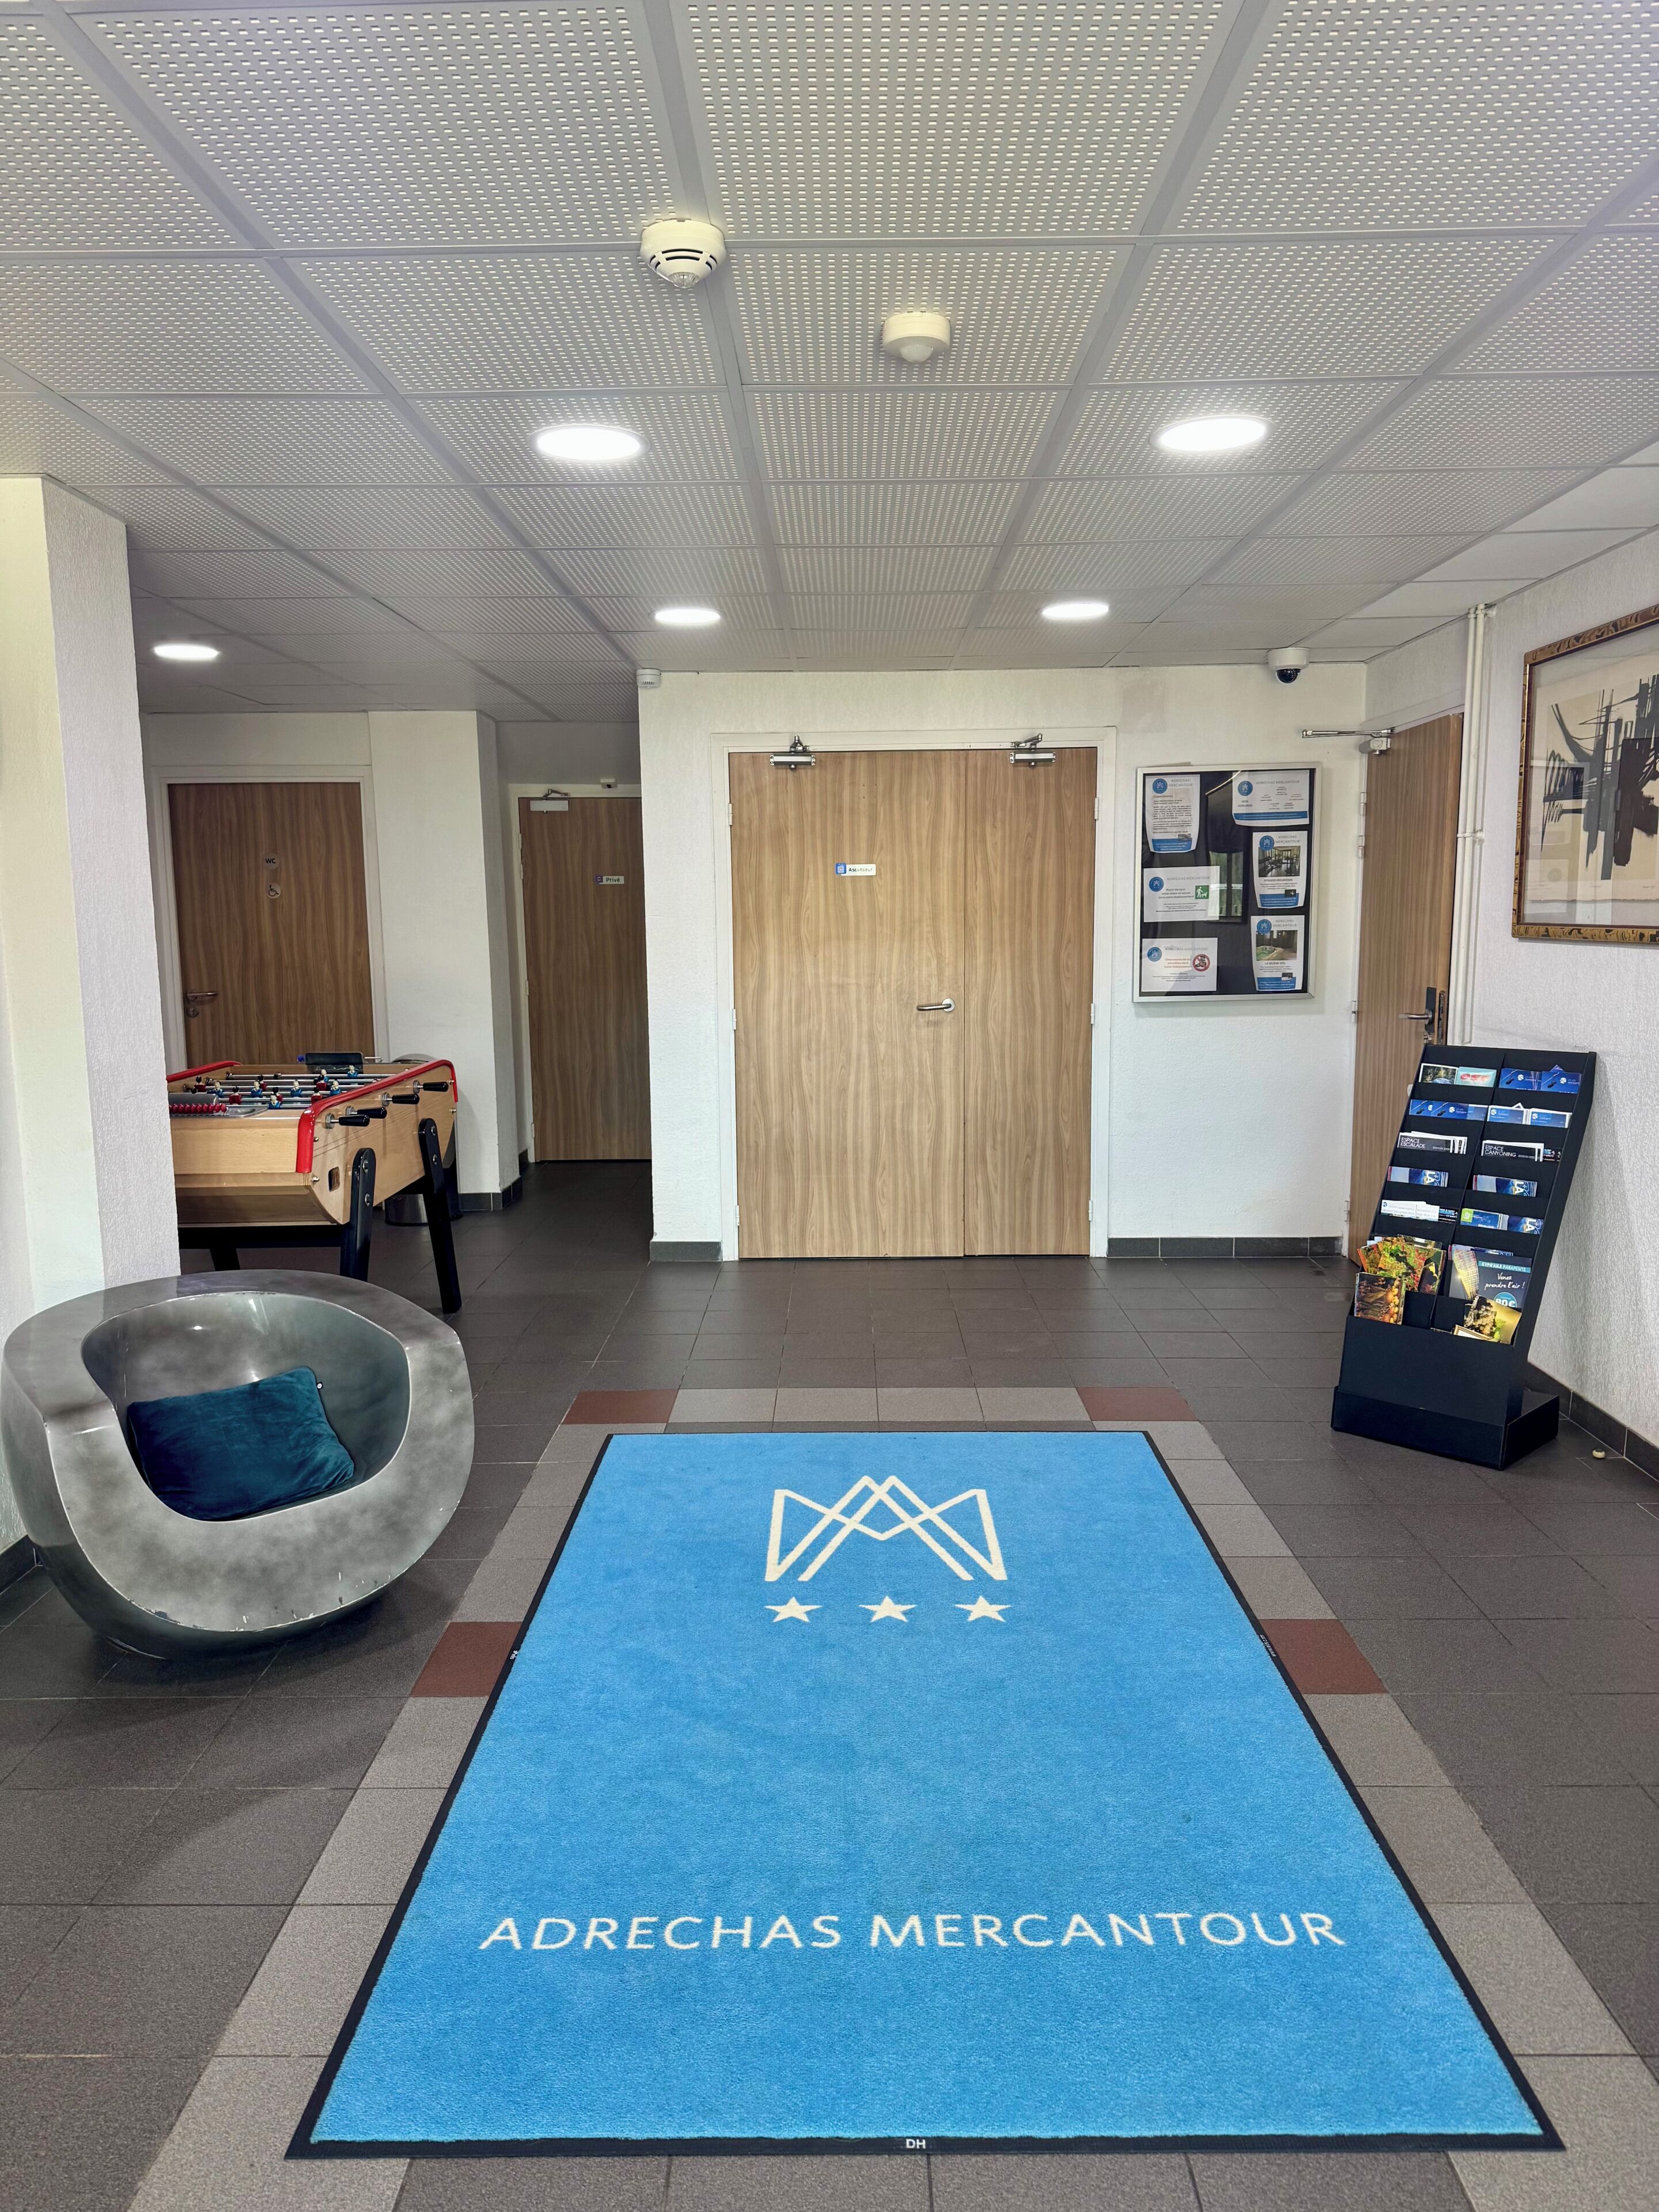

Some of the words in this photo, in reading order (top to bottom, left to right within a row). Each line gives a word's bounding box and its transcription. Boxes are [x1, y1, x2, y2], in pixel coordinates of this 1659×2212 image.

[1502, 1264, 1526, 1272] PARAPENTE
[1497, 1272, 1512, 1280] Venez
[1484, 1281, 1507, 1291] prendre
[479, 1915, 842, 1950] ADRECHAS
[869, 1912, 1346, 1948] MERCANTOUR
[906, 2138, 926, 2149] DH
